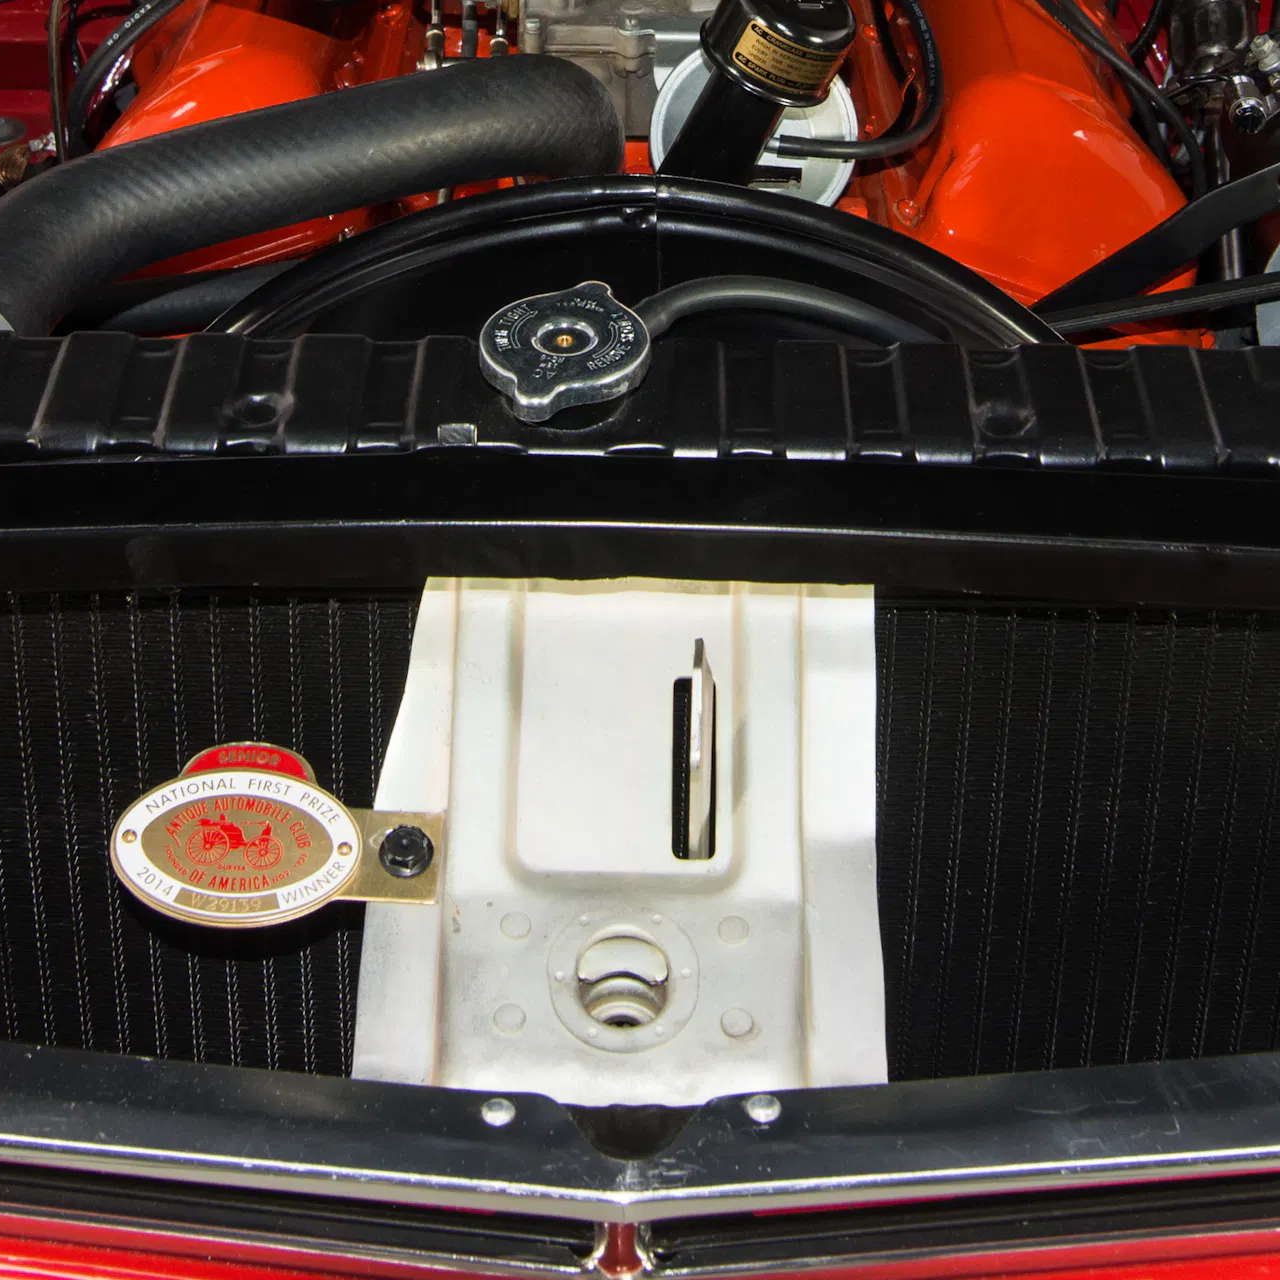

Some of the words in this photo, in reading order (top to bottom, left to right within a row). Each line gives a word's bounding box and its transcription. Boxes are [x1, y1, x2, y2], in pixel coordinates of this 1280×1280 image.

[751, 45, 768, 57] EVERY
[753, 25, 763, 34] AC
[767, 35, 804, 56] CRANKCASE
[755, 39, 771, 51] WASH
[738, 54, 747, 63] AC
[748, 61, 768, 77] SPARK
[769, 74, 786, 85] PLUG
[748, 50, 766, 64] UNDER
[498, 303, 532, 326] TIGHT
[586, 343, 632, 371] REMOVE
[218, 749, 281, 766] SENIOR
[146, 778, 237, 815] NATIONAL
[248, 778, 293, 796] FIRST
[299, 792, 341, 823] PRIZE
[165, 800, 209, 846] ANTIQUE
[213, 796, 293, 824] AUTOMOBILE
[289, 820, 313, 849] CLUB
[137, 867, 173, 897] 2014
[189, 869, 208, 885] OF
[208, 874, 270, 891] AMERICA
[281, 861, 346, 905] WINNER
[191, 892, 262, 913] W29139
